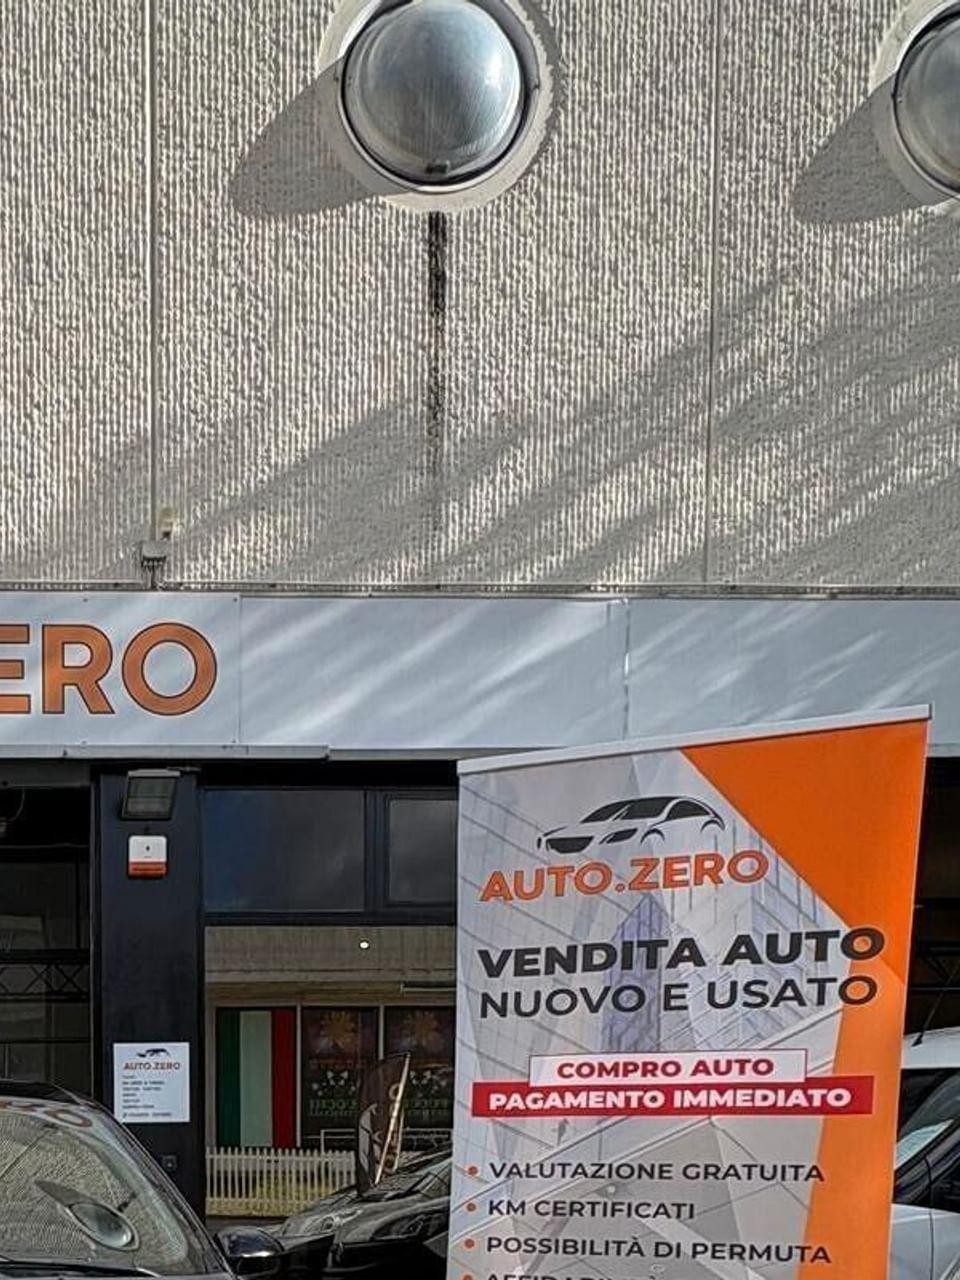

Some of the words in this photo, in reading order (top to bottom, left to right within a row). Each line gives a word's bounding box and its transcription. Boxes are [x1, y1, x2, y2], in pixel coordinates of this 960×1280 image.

[480, 849, 770, 903] AUTO.ZERO
[477, 936, 707, 979] VENDITA
[721, 926, 886, 966] AUTO
[480, 983, 644, 1019] NUOVO
[663, 982, 688, 1012] E
[707, 974, 878, 1010] USATO
[556, 1059, 682, 1080] COMPRO
[691, 1057, 774, 1077] AUTO
[488, 1088, 665, 1111] PAGAMENTO
[673, 1087, 852, 1109] IMMEDIATO
[490, 1162, 674, 1181] VALUTAZIONE
[682, 1163, 825, 1183] GRATUITA
[488, 1199, 526, 1217] KM
[534, 1200, 695, 1220] CERTIFICATI
[486, 1236, 645, 1259] POSSIBILITÀ
[654, 1242, 682, 1259] DI
[692, 1243, 832, 1264] PERMUTA
